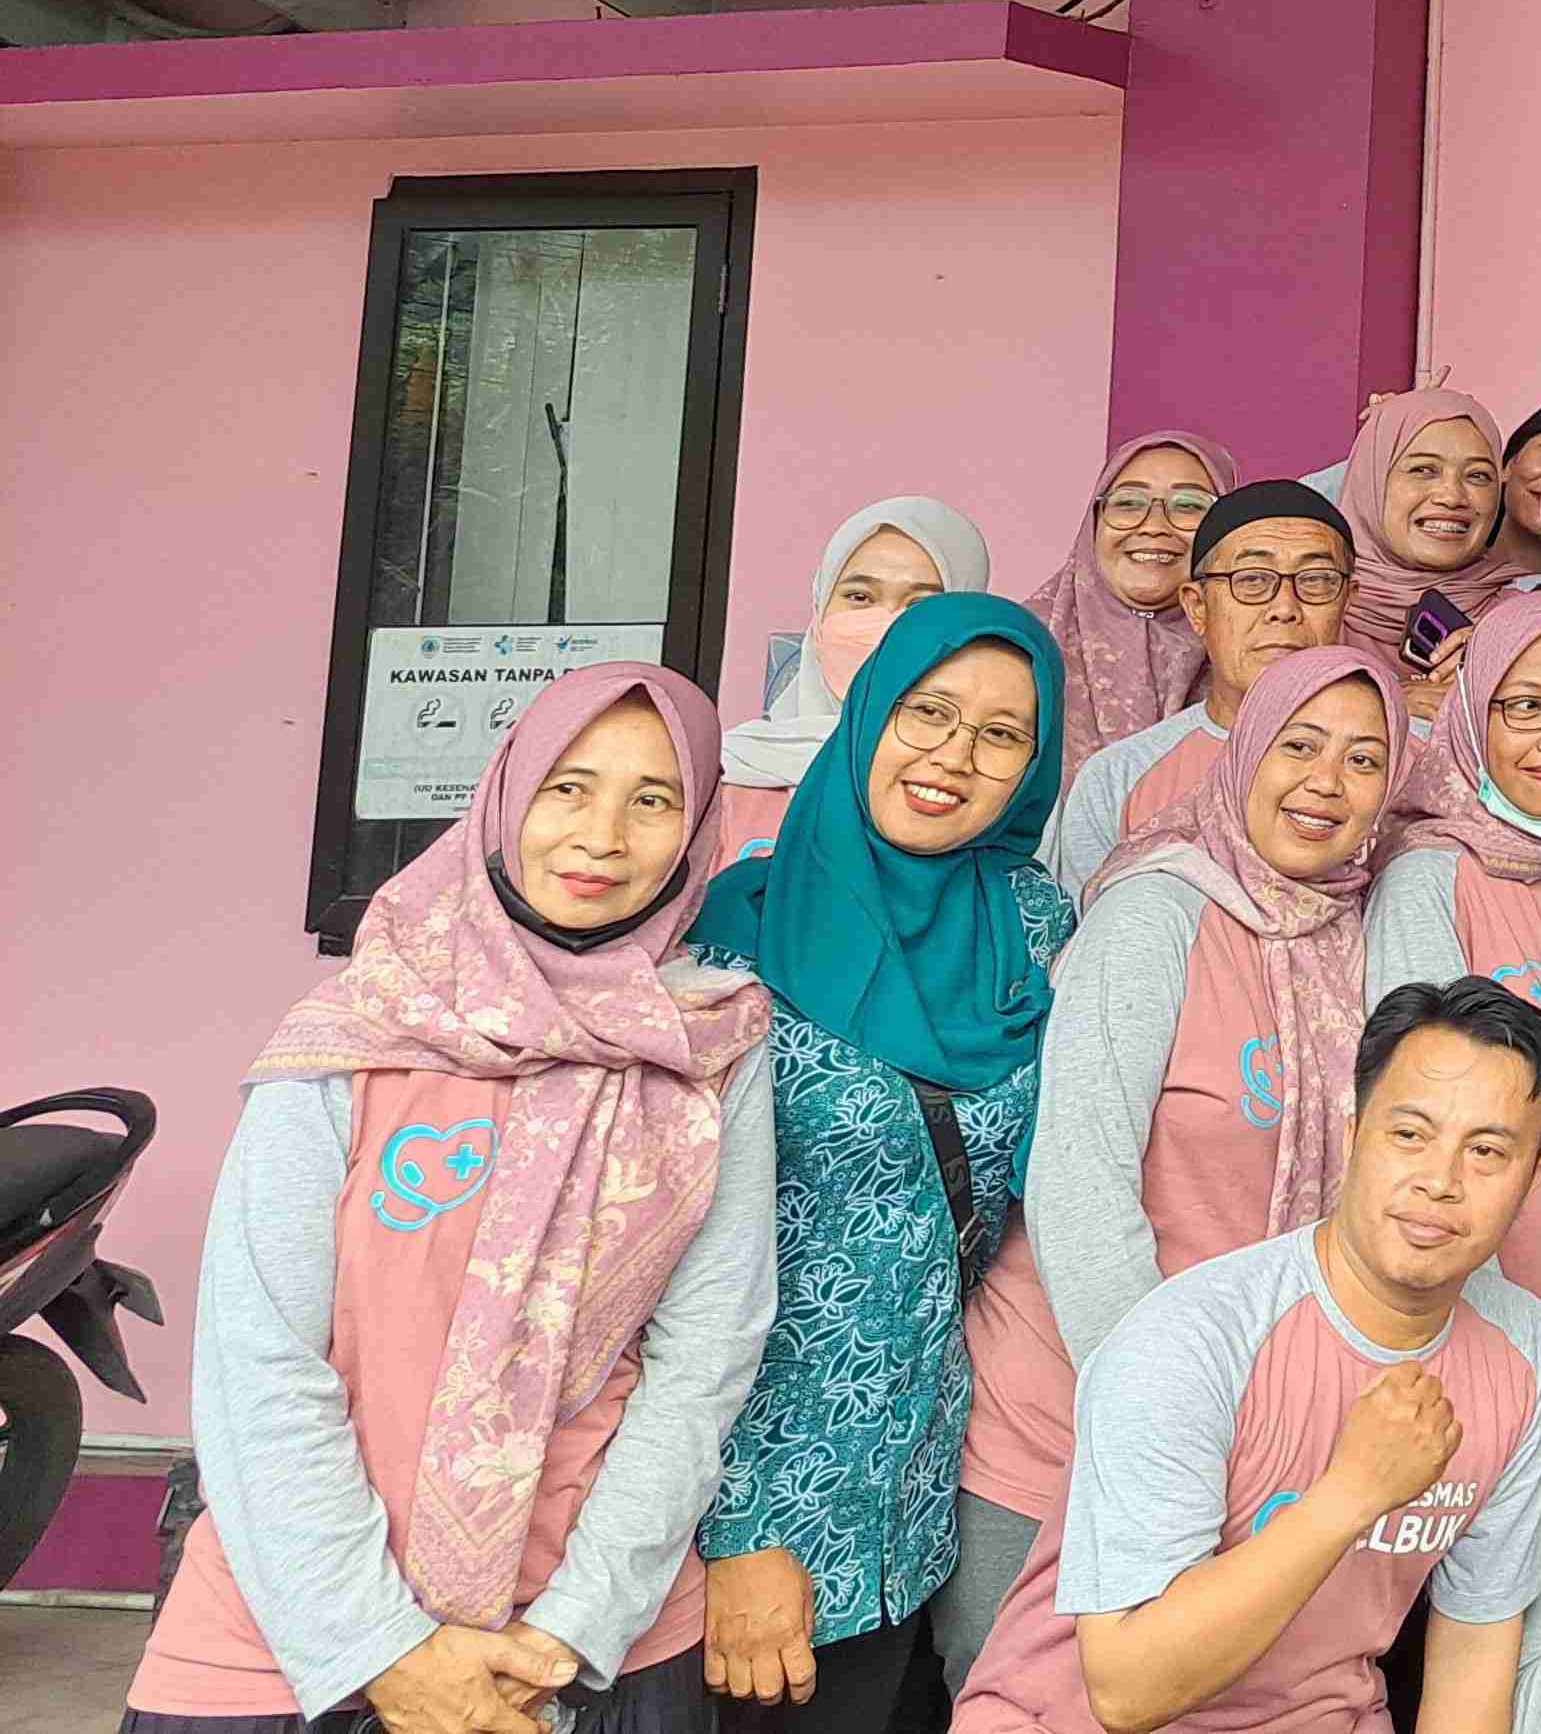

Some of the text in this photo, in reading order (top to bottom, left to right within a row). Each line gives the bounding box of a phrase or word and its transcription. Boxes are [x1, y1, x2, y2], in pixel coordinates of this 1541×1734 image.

[390, 668, 488, 684] KAWASAN
[494, 667, 556, 683] TANPA
[1355, 1513, 1467, 1554] LBUK
